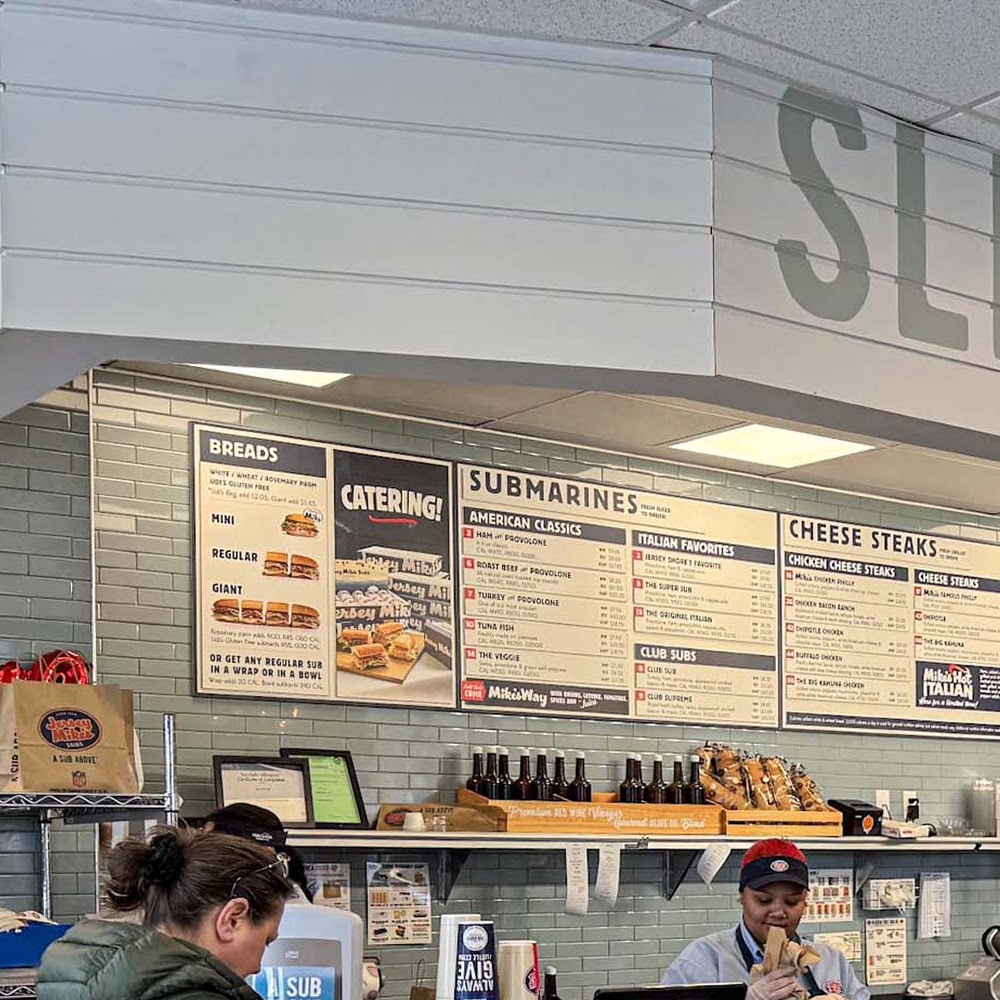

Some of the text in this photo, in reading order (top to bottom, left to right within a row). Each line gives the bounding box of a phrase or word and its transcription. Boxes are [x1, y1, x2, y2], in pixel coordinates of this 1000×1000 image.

[210, 439, 278, 462] BREADS
[210, 469, 229, 477] WHITE
[237, 471, 258, 480] WHEAT
[265, 476, 298, 485] ROSEMARY
[229, 480, 253, 489] GLUTEN
[470, 469, 638, 514] SUBMARINES
[341, 484, 443, 522] CATERING!
[212, 514, 234, 525] MINI
[470, 511, 582, 536] AMERICAN CLASSICS
[477, 531, 492, 539] HAM
[505, 534, 547, 546] PROVOLONE
[638, 533, 734, 557] ITALIAN FAVORITES
[790, 519, 936, 557] CHEESE STEAKS
[212, 549, 258, 562] REGULAR
[645, 553, 665, 562] JERSEY
[694, 560, 721, 570] FAVORITE
[477, 561, 572, 579] ROAST BEEF PROVOLONE
[789, 554, 895, 578] CHICKEN CHEESE STEAKS
[659, 583, 676, 591] SUPER
[918, 571, 979, 588] CHEESE STEAKS
[212, 583, 242, 595] GIANT
[478, 592, 559, 606] TURKEY PROVOLONE
[659, 611, 688, 621] ORIGINAL
[690, 614, 712, 623] ITALIAN
[478, 622, 497, 631] TUNA
[500, 623, 514, 631] FISH
[796, 626, 821, 634] CHIPOTLE
[480, 651, 493, 659] THE
[496, 652, 520, 661] VEGGIE
[640, 646, 697, 661] CLUB SUBS
[210, 654, 322, 669] OR GET ANY REGULAR SUB
[233, 667, 258, 675] WRAP
[262, 668, 273, 676] OR
[277, 669, 286, 677] IN
[290, 670, 295, 678] A
[299, 671, 322, 680] BOWL
[521, 689, 547, 707] Way
[923, 681, 973, 700] ITALIAN
[46, 716, 93, 730] Jersey
[53, 755, 97, 764] A SUB ABOVE
[508, 805, 552, 818] Premium
[554, 807, 567, 817] RED
[570, 808, 586, 818] WINE
[458, 961, 493, 979] GIVE
[287, 977, 322, 998] SUB
[457, 980, 494, 992] ALWAYS
